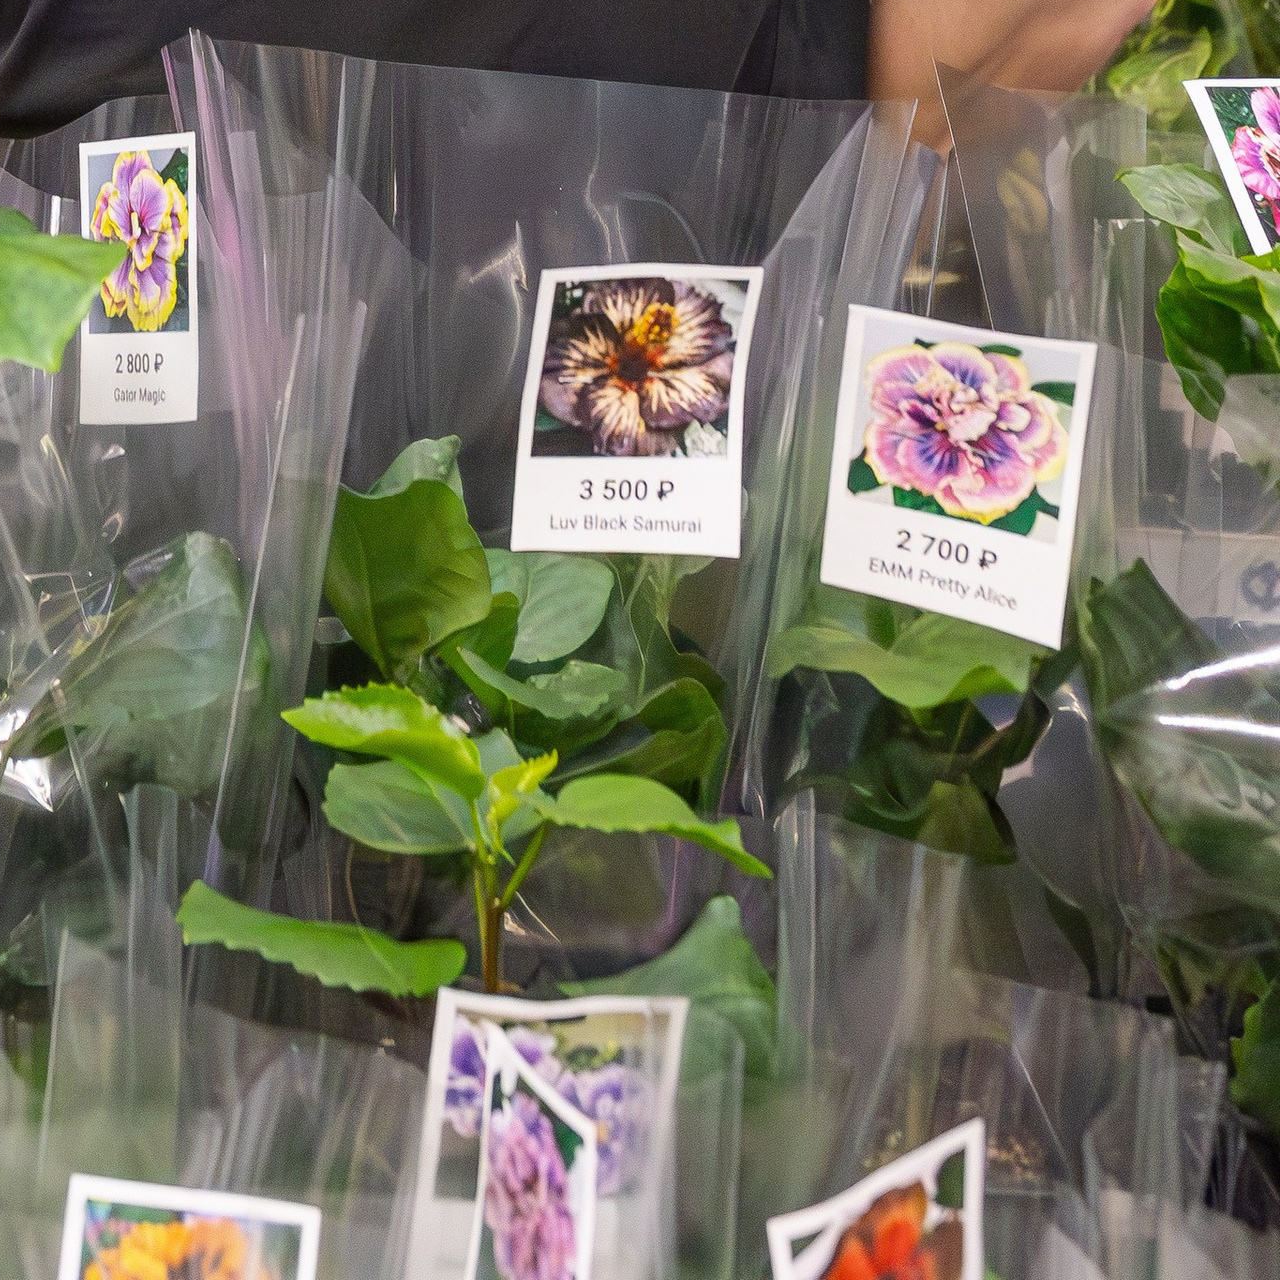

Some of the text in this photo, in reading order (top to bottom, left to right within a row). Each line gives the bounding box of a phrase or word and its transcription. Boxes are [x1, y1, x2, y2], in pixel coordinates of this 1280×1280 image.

[115, 353, 123, 374] 2
[126, 353, 151, 374] 800
[113, 387, 166, 406] Gator Magic
[579, 478, 594, 501] 3
[602, 478, 649, 501] 500
[549, 513, 703, 534] Luv Black Samurai
[896, 528, 912, 552] 2
[920, 533, 970, 565] 700
[869, 556, 1019, 611] EMM Pretty Alice
